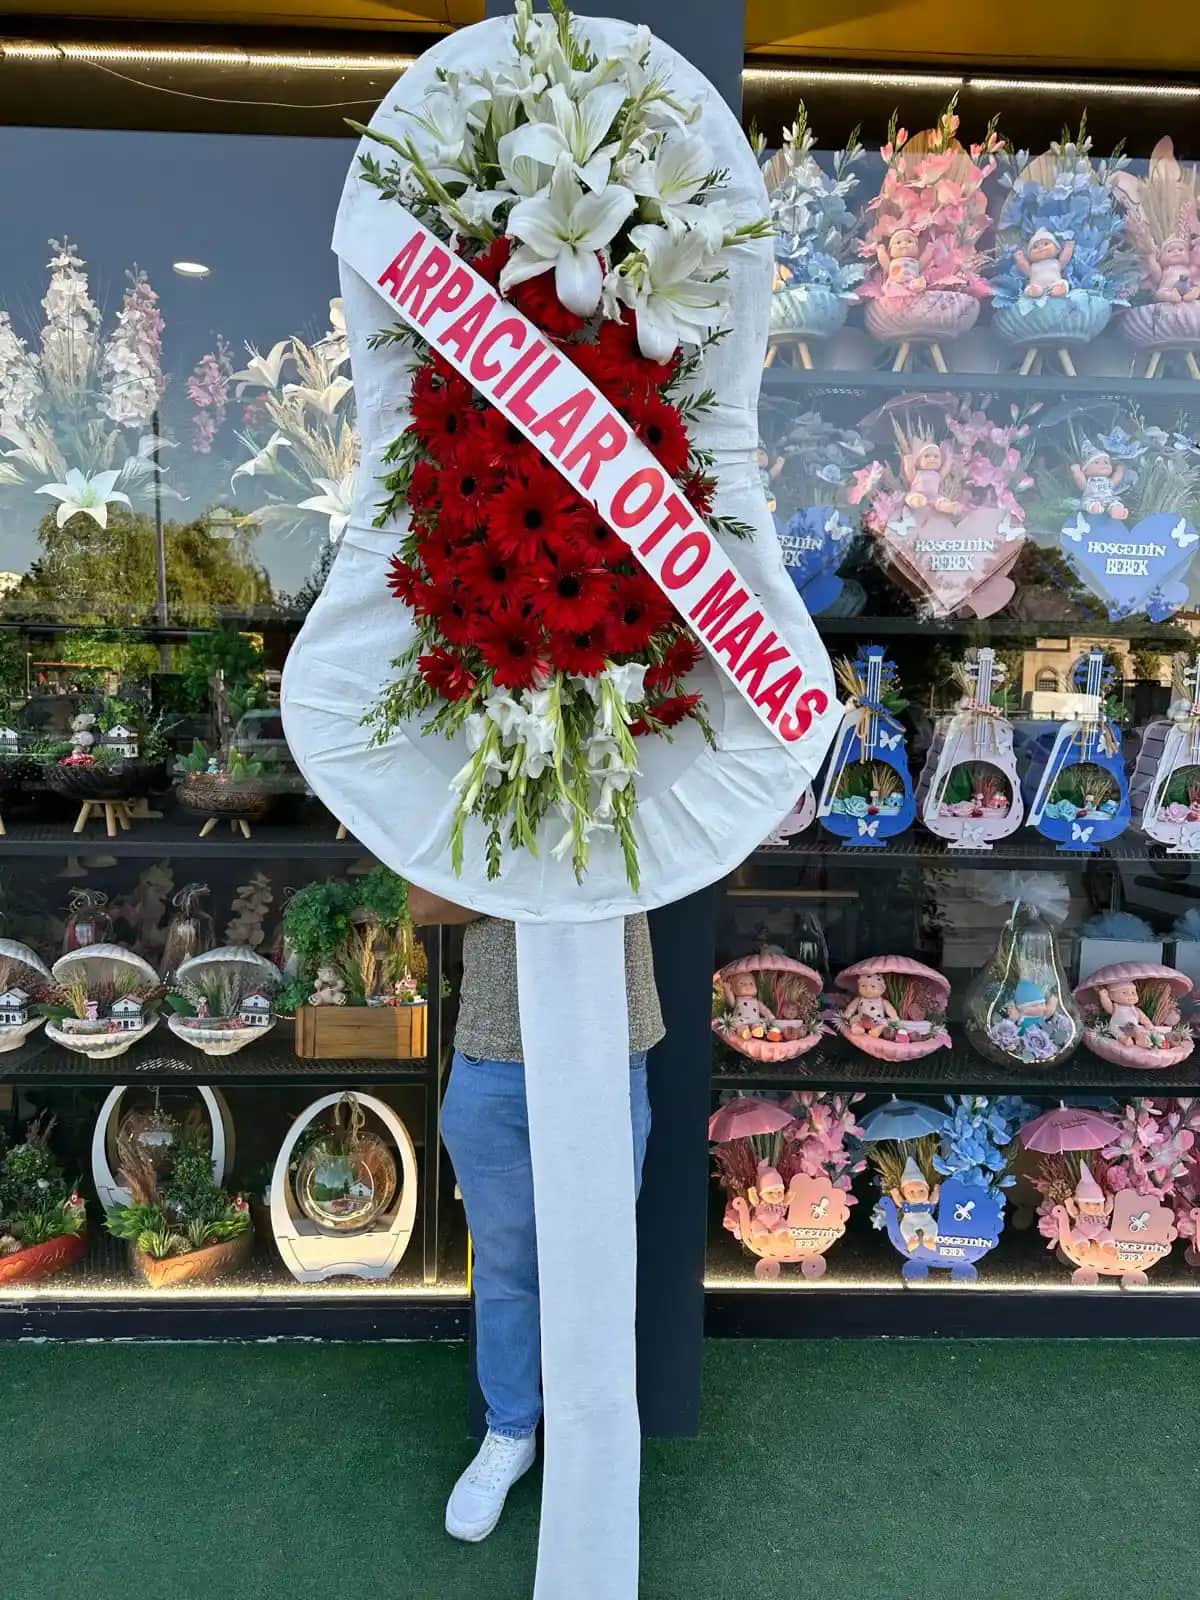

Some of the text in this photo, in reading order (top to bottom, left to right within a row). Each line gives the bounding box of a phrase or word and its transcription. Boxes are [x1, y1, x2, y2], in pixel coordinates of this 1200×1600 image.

[378, 231, 829, 743] ARPACILAR OTO MAKAS
[1105, 558, 1149, 576] BEBEK
